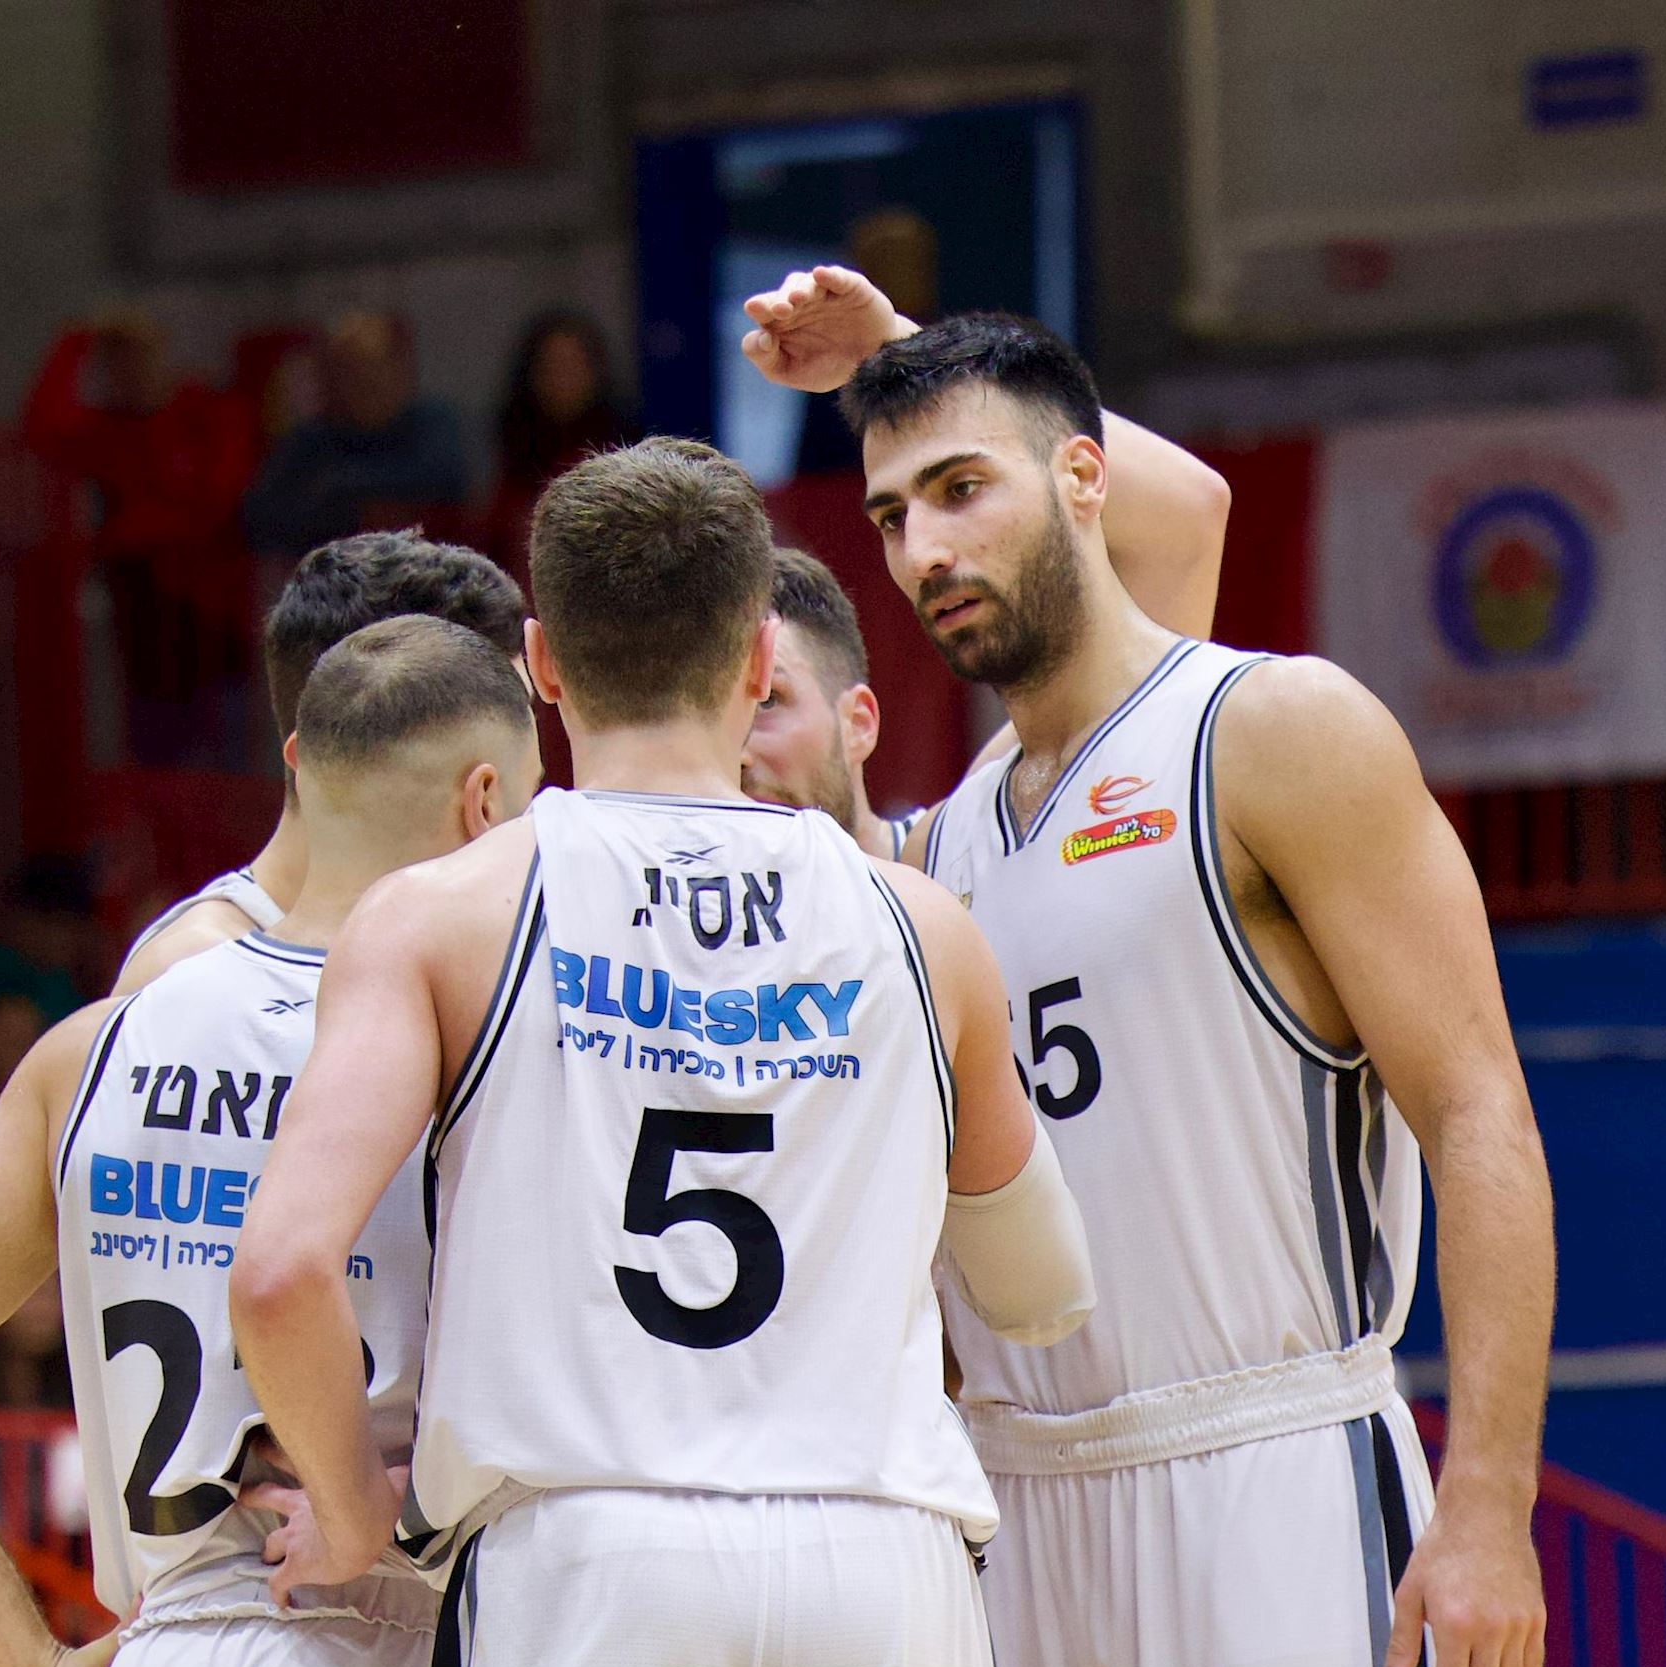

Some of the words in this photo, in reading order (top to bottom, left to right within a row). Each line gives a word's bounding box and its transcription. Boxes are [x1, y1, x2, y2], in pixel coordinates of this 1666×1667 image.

[1072, 829, 1141, 859] Winner
[550, 946, 864, 1046] BLUESKY
[557, 1022, 617, 1058] ליסי
[1008, 976, 1102, 1121] 5
[639, 1045, 726, 1080] מכירה
[755, 1053, 861, 1080] השכרה
[90, 1153, 262, 1228] BLUE
[614, 1107, 785, 1350] 5
[90, 1231, 158, 1262] ליסינג
[178, 1241, 235, 1268] כירה
